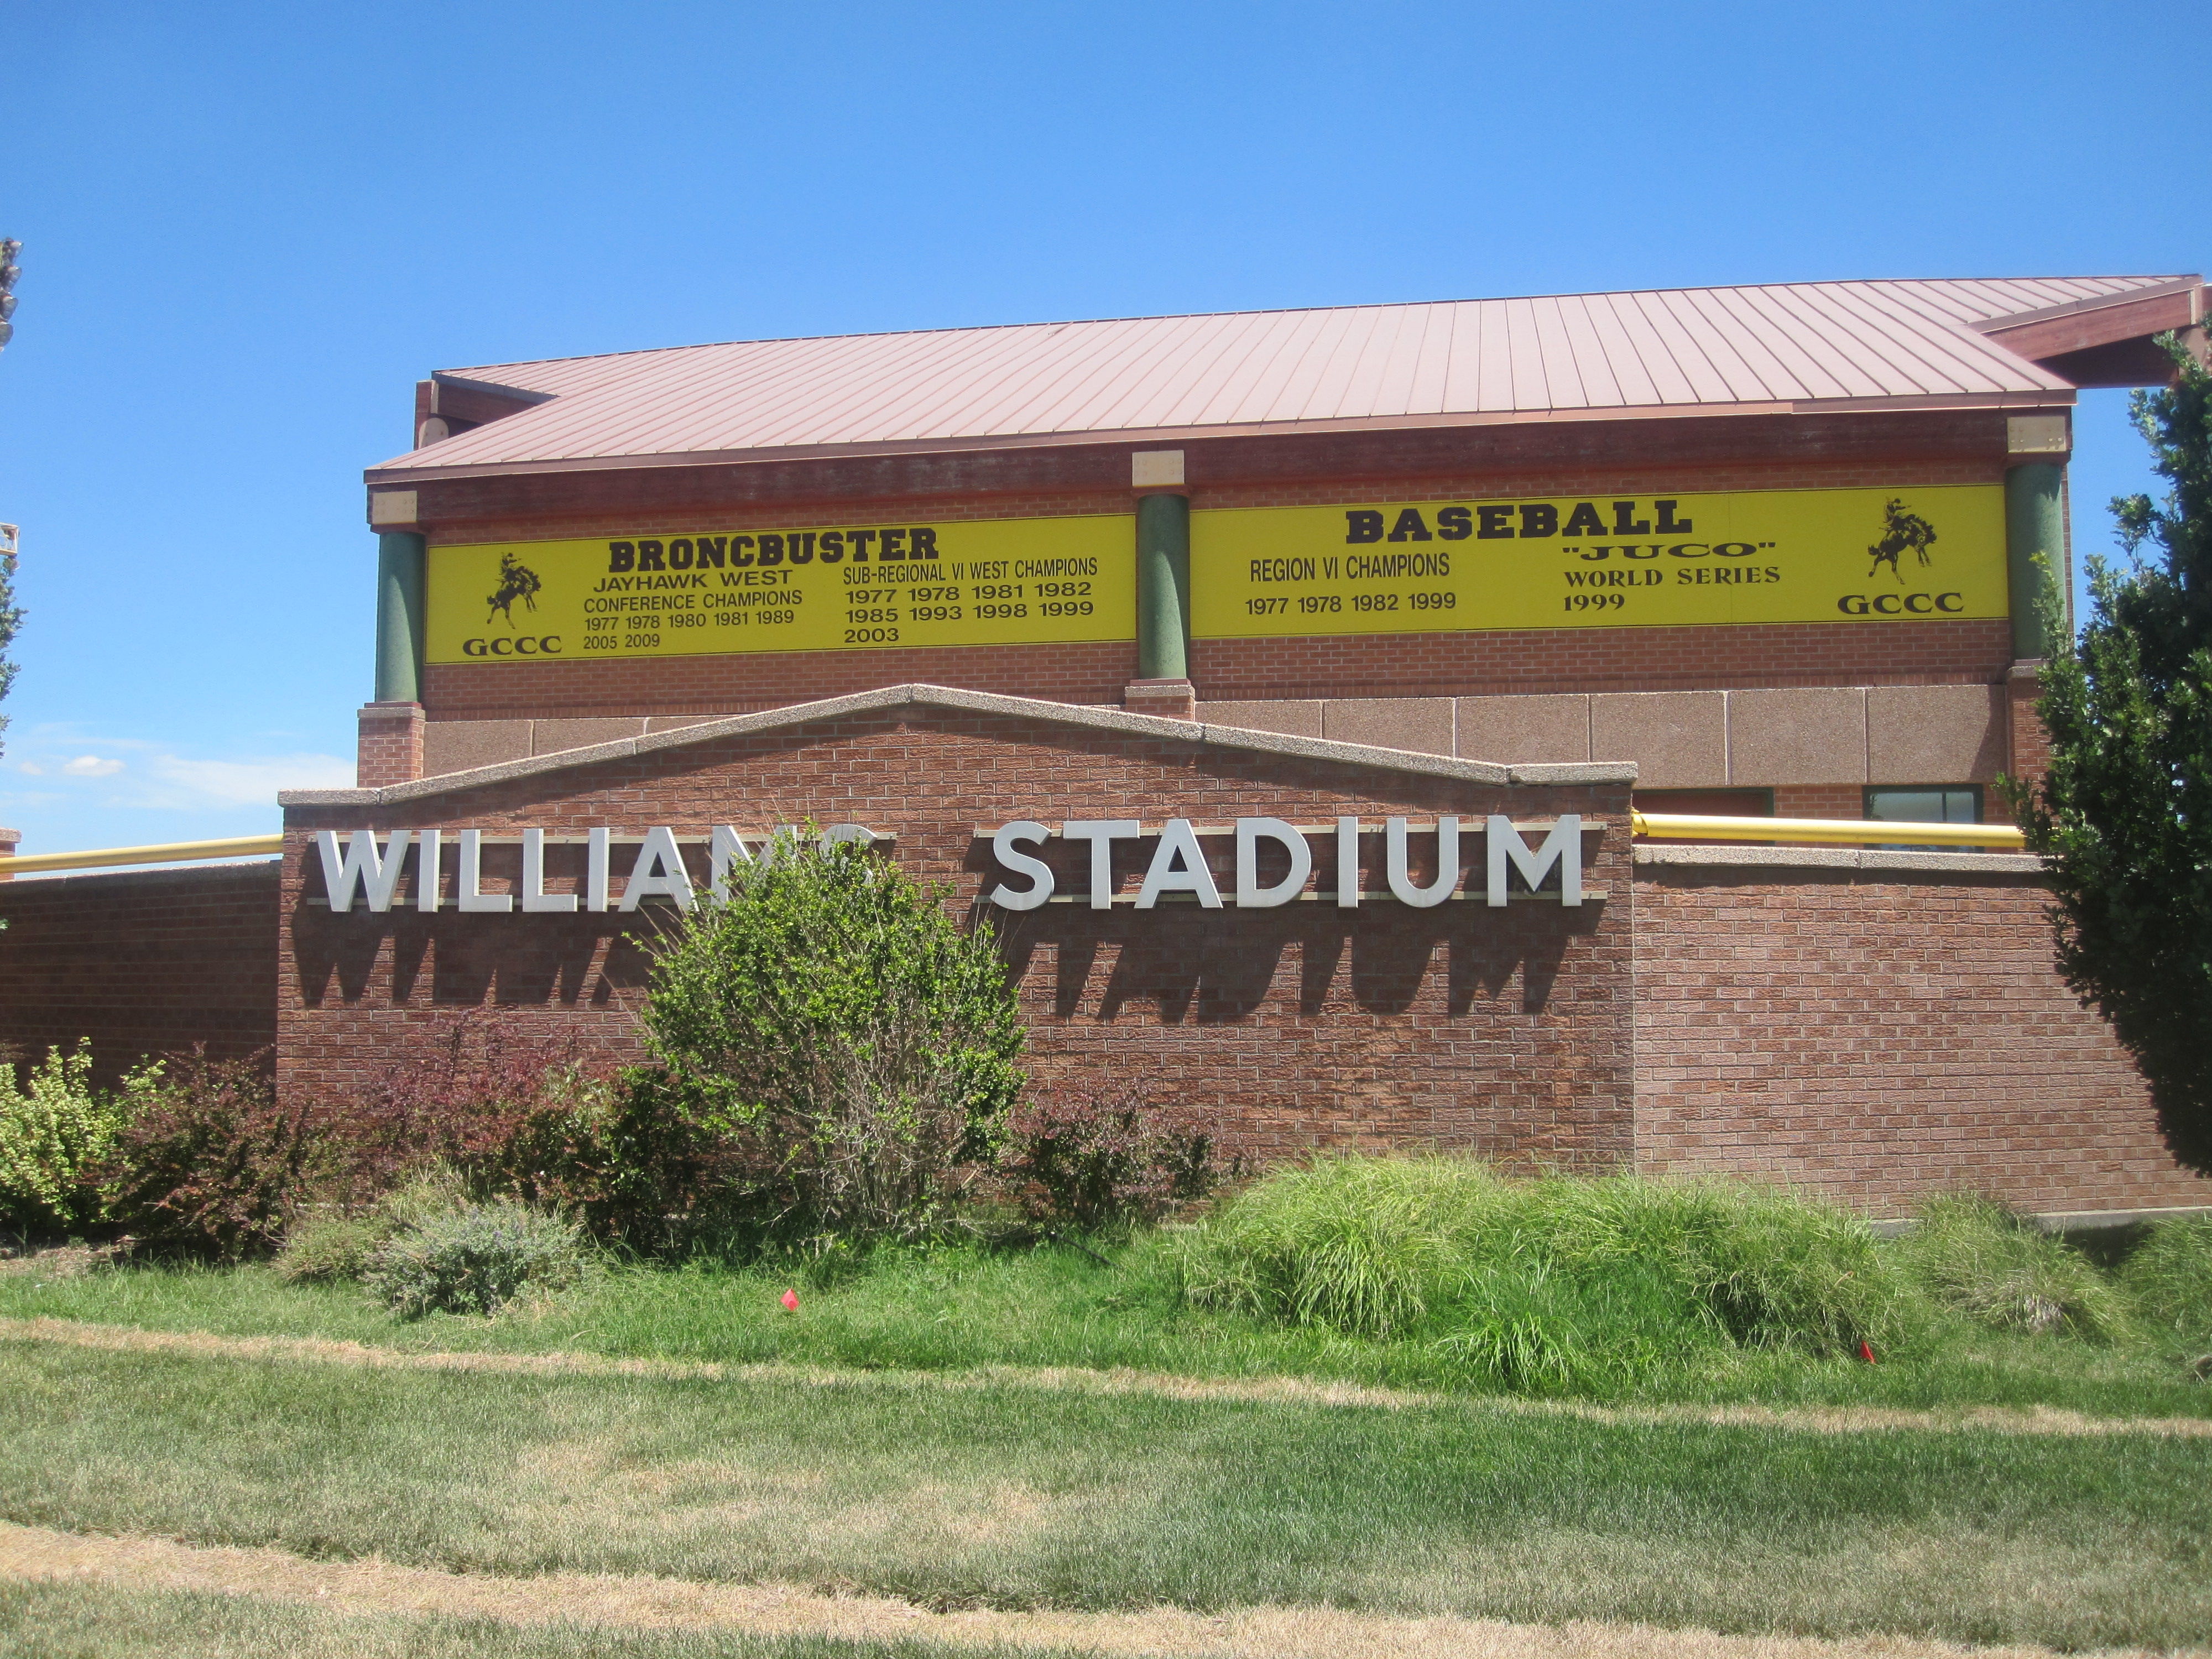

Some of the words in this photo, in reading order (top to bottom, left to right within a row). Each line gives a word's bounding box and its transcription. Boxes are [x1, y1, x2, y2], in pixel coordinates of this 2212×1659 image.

[1345, 499, 1693, 544] BASEBALL
[609, 527, 939, 573] BRONCBUSTER
[1562, 542, 1776, 561] "JUCO"
[843, 563, 946, 585] SUB-REGIONAL
[952, 562, 964, 581] VI
[969, 560, 1009, 580] WEST
[1015, 557, 1098, 578] CHAMPIONS
[1250, 557, 1315, 582] REGION
[1323, 556, 1338, 580] VI
[1346, 552, 1450, 578] CHAMPIONS
[1564, 569, 1663, 587] WORLD
[1677, 566, 1780, 585] SERIES
[593, 573, 708, 593] JAYHAWK
[719, 569, 793, 587] WEST
[845, 589, 897, 604] 1977
[907, 586, 960, 602] 1978
[971, 584, 1022, 599] 1981
[1034, 581, 1092, 597] 1982
[584, 594, 695, 613] CONFERENCE
[703, 589, 802, 609] CHAMPIONS
[845, 608, 899, 623] 1985
[909, 606, 962, 621] 1993
[973, 603, 1027, 619] 1998
[1038, 601, 1094, 617] 1999
[1245, 597, 1289, 615] 1977
[1297, 596, 1342, 613] 1978
[1351, 594, 1399, 612] 1982
[1408, 592, 1456, 610] 1999
[1564, 593, 1625, 611] 1999
[1837, 592, 1964, 615] GCCC
[585, 617, 619, 631] 1977
[625, 615, 660, 629] 1978
[667, 613, 706, 628] 1980
[713, 612, 748, 626] 1981
[755, 609, 794, 624] 1989
[462, 635, 561, 656] GCCC
[583, 635, 617, 649] 2005
[624, 633, 660, 648] 2009
[844, 628, 899, 643] 2003
[989, 814, 1583, 911] STADIUM
